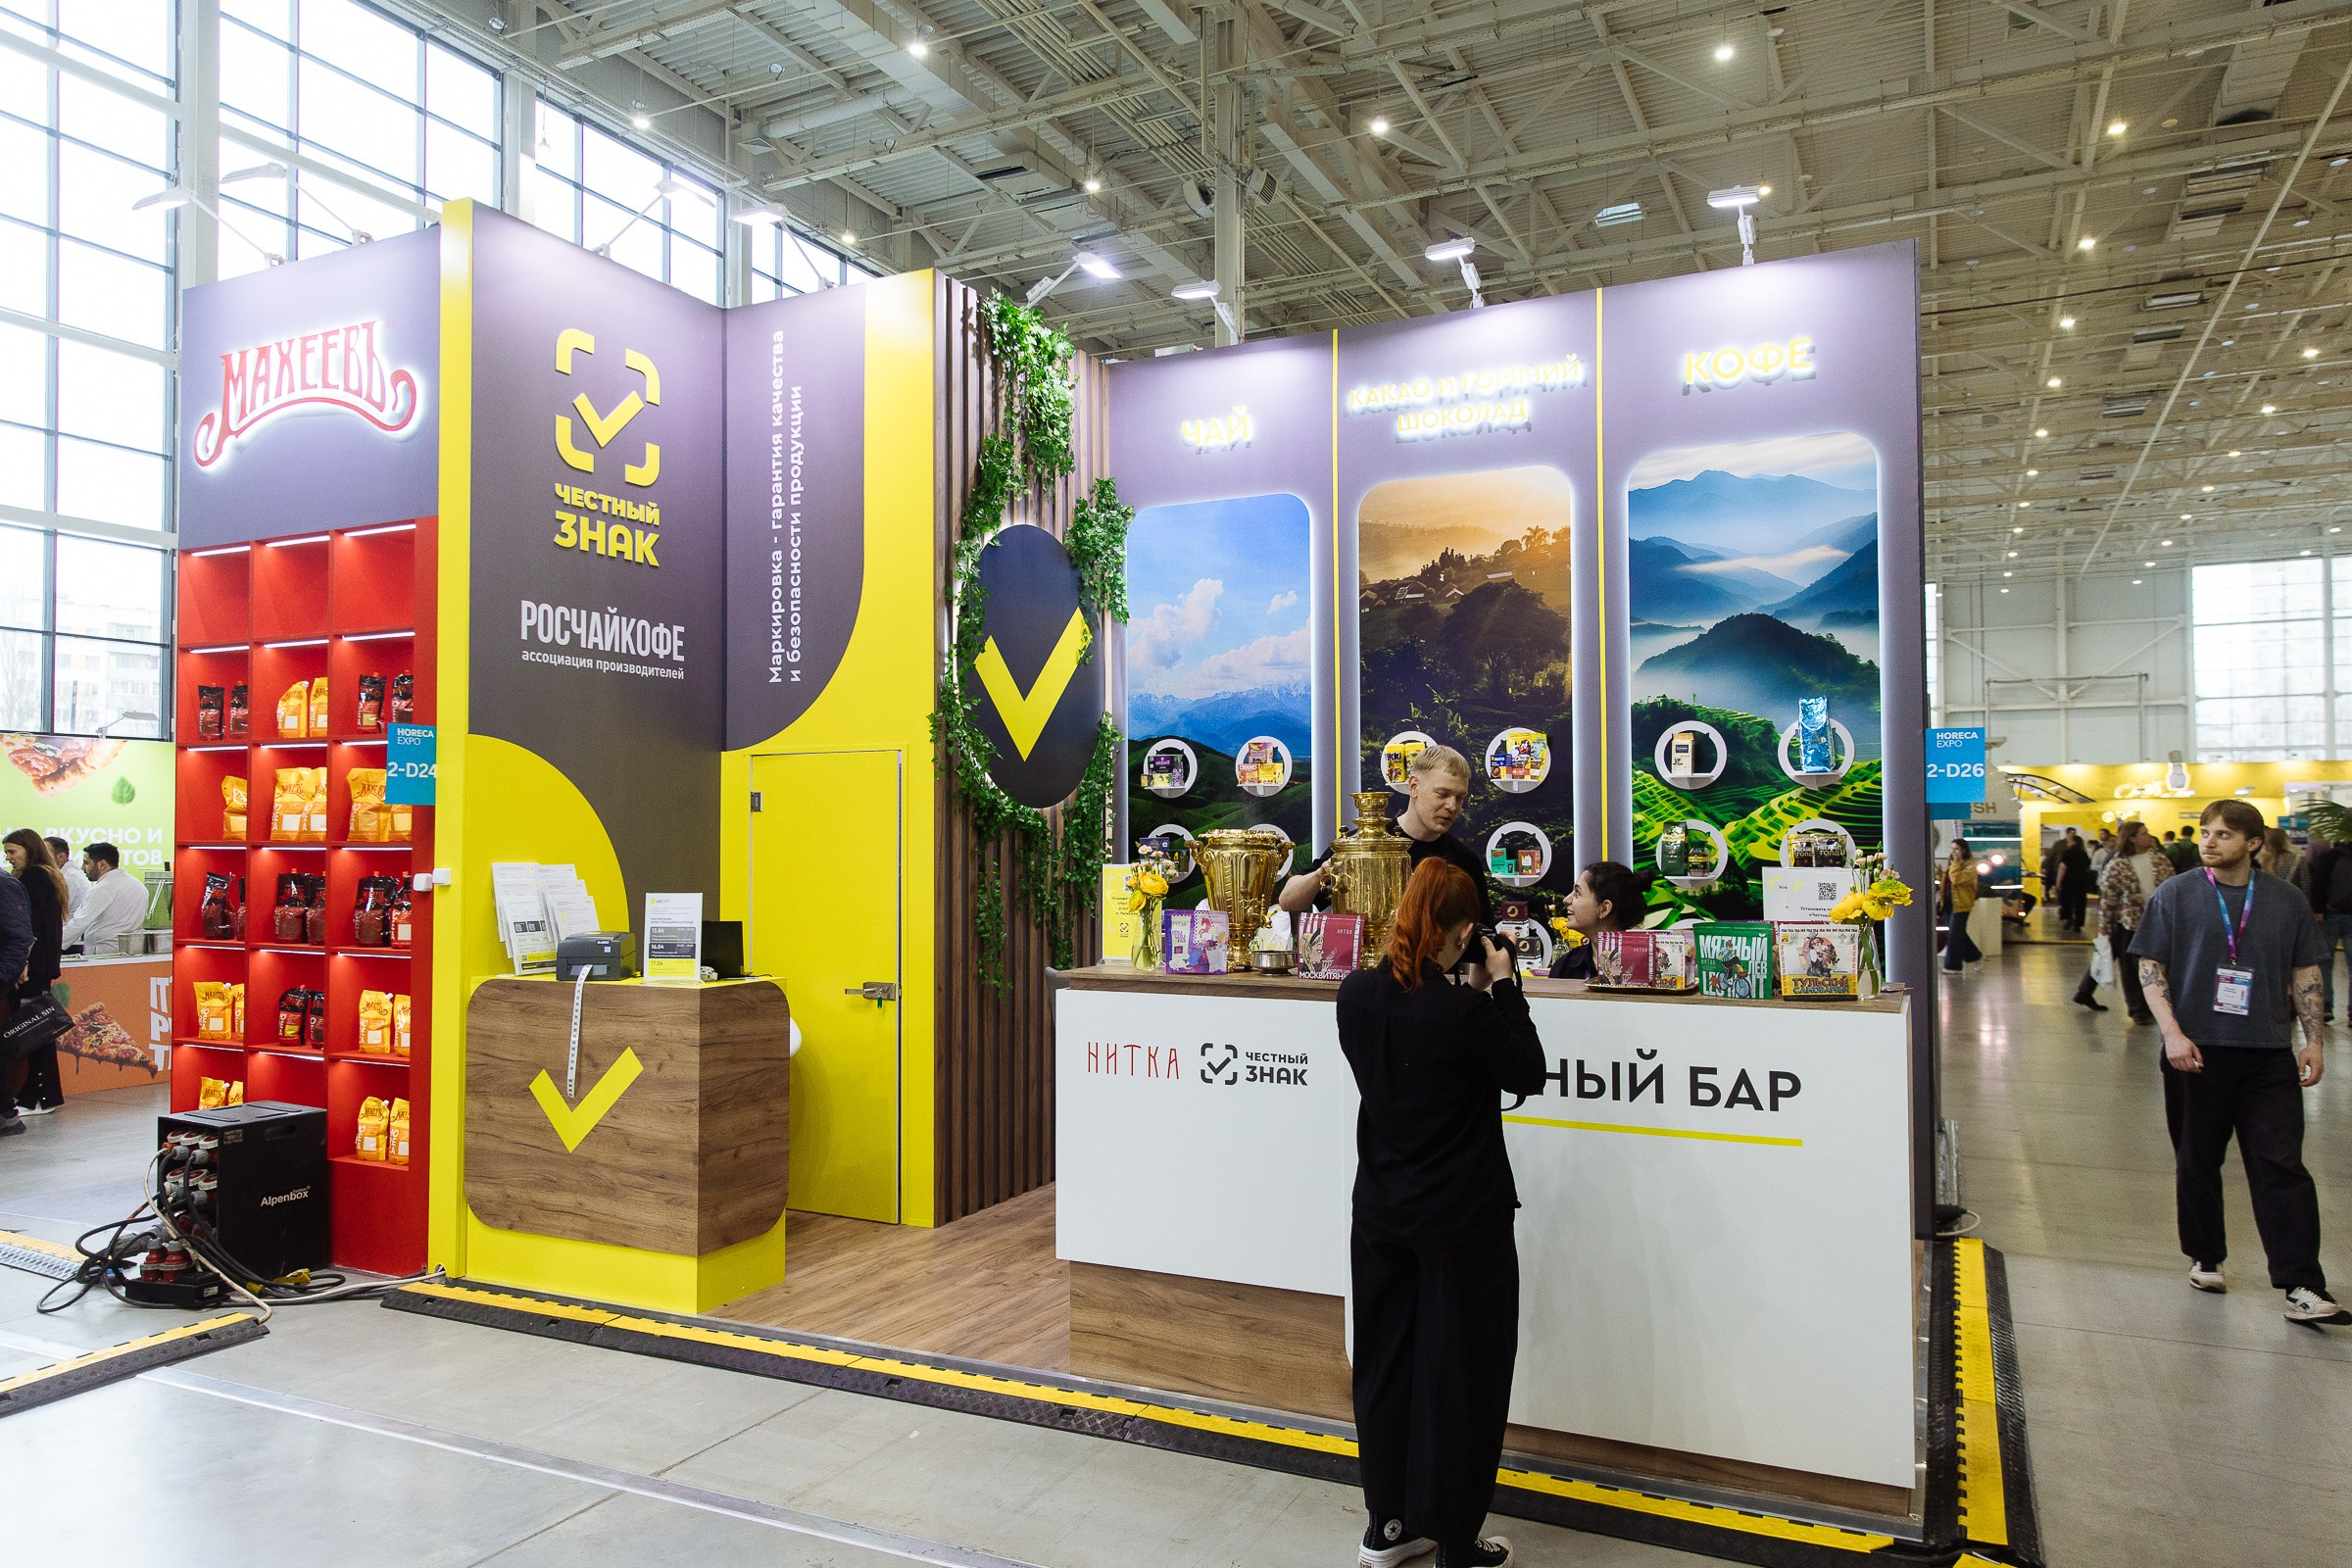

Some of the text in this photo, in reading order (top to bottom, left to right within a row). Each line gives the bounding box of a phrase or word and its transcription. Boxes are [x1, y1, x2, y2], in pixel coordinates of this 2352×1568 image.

[771, 330, 784, 427] качества
[1685, 337, 1812, 384] КОФЕ
[1348, 352, 1581, 408] КАКАО И ГОРЯЧИЙ
[1180, 404, 1250, 447] ЧАЙ
[1396, 398, 1529, 433] ШОКОЛАД
[771, 433, 785, 529] гарантия
[554, 482, 661, 526] ЧЕСТНЫЙ
[553, 510, 661, 567] ЗНАК
[786, 386, 805, 682] и безопасности продукции
[519, 599, 685, 662] РОСЧАЙКОФЕ
[769, 550, 785, 683] Маркировка
[520, 649, 685, 681] ассоциация производителей
[396, 727, 435, 739] HORECA
[396, 737, 421, 746] EXPO
[1936, 731, 1979, 740] HORECA
[387, 760, 437, 779] 2-D24
[1927, 762, 1985, 778] 2-D26
[45, 827, 163, 845] ВКУСНО И
[3, 1014, 42, 1039] ORIGINAL
[41, 1005, 57, 1019] SIN
[1087, 1041, 1180, 1080] НИТКА
[1245, 1051, 1309, 1065] ЧЕСТНЫЙ
[1245, 1064, 1308, 1087] ЗНАК
[1689, 1066, 1801, 1112] БАР
[260, 1190, 310, 1207] Alpenbox
